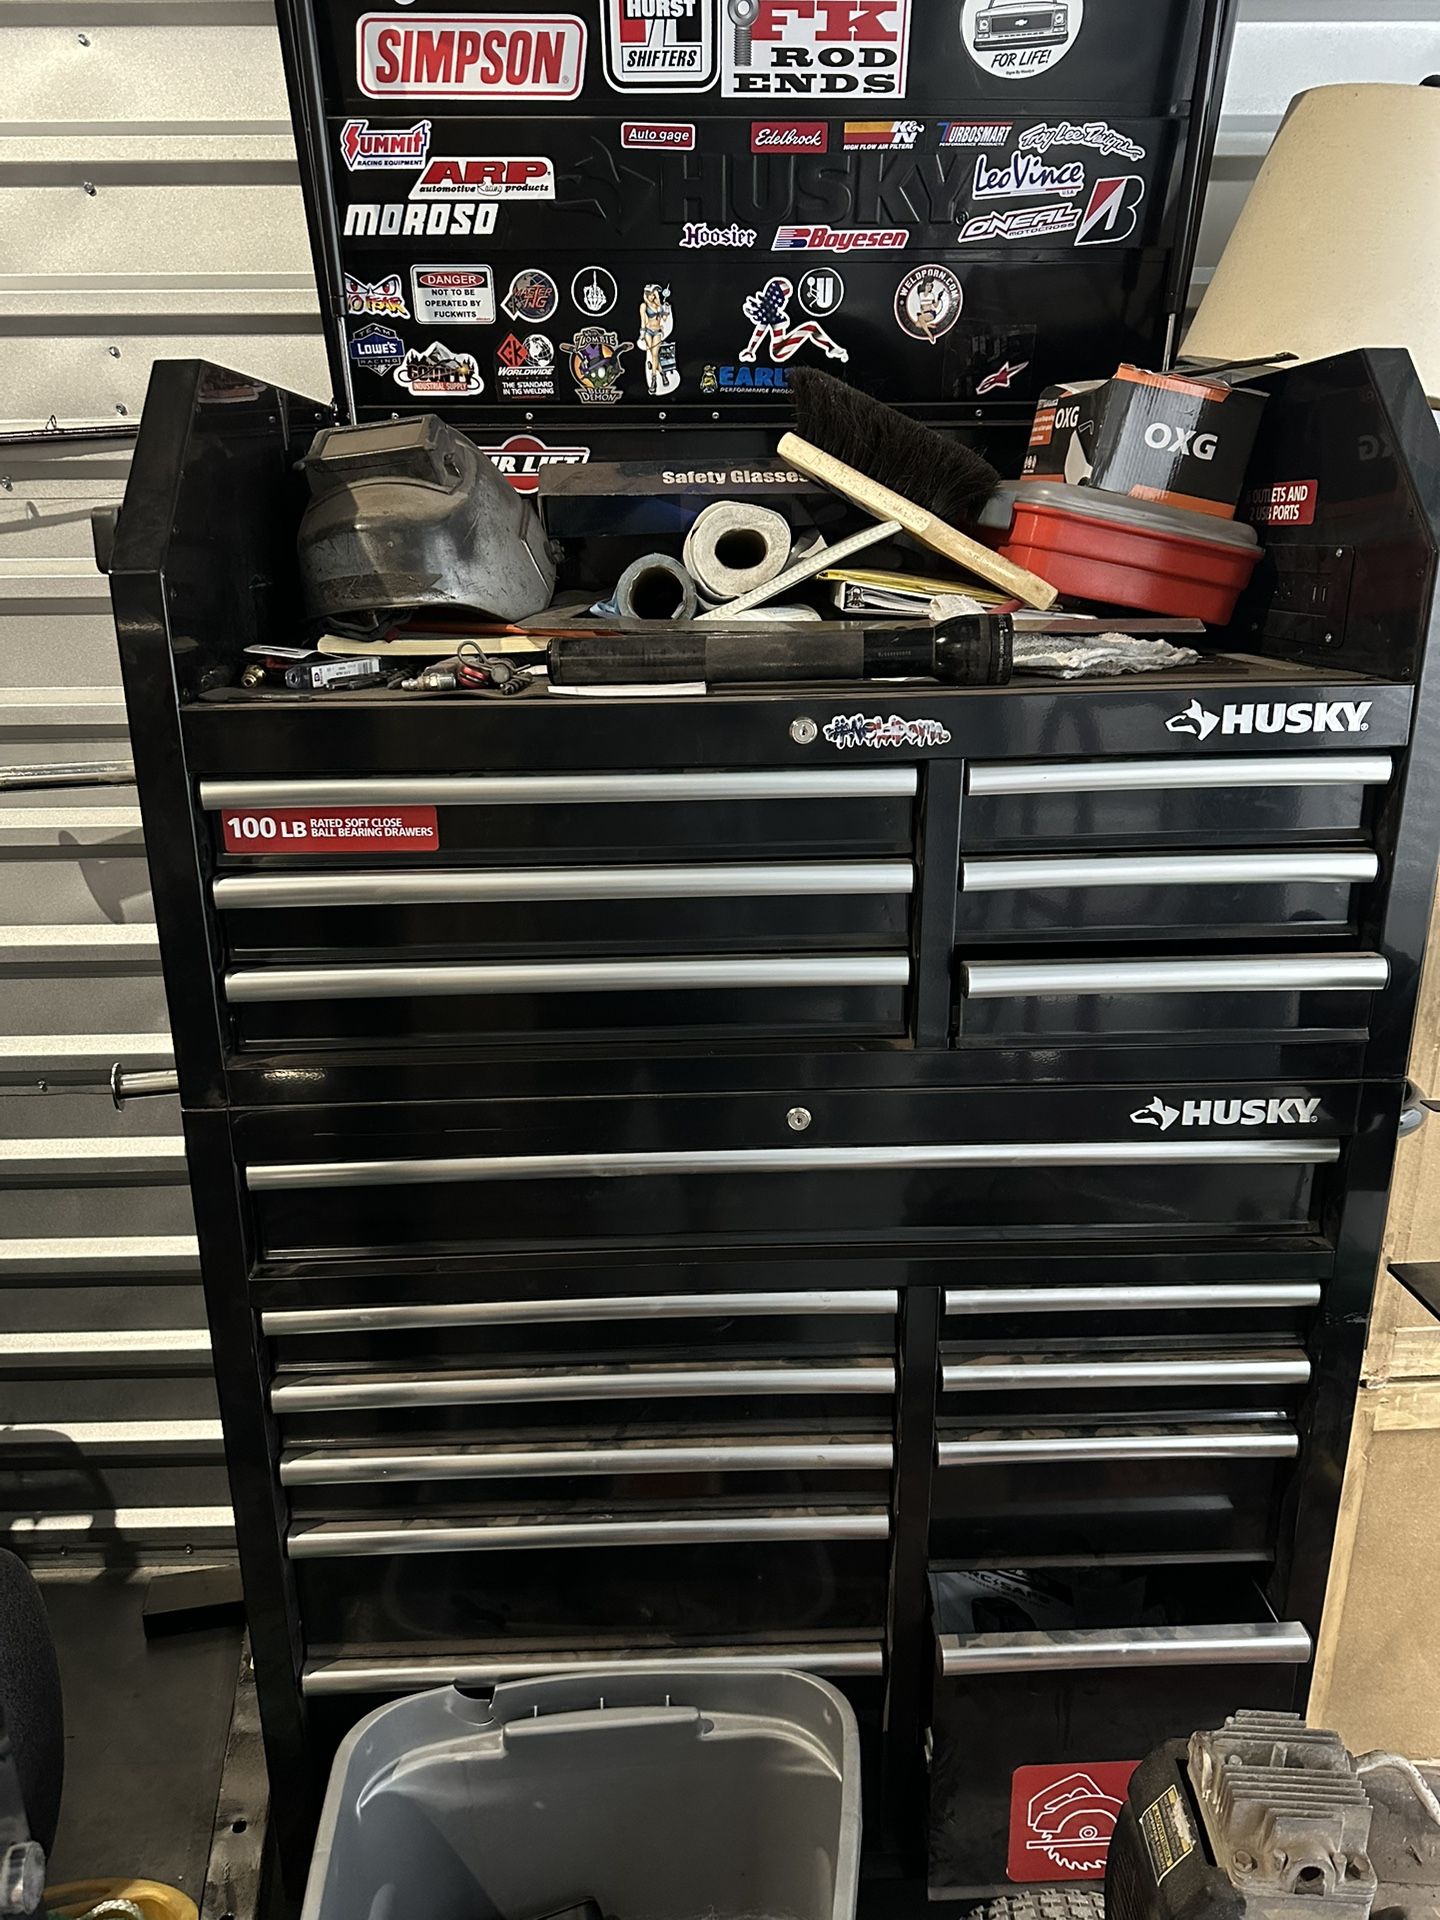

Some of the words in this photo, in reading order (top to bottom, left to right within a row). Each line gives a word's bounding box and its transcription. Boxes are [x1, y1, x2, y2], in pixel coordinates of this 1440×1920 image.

[627, 0, 696, 17] HURST
[751, 1, 897, 41] FK
[376, 28, 565, 85] SIMPSON
[627, 50, 697, 67] SHIFTERS
[771, 47, 897, 67] ROD
[991, 53, 1017, 68] FOR
[1019, 49, 1052, 66] LIFE!
[733, 73, 895, 93] ENDS
[629, 128, 656, 141] Auto
[659, 130, 689, 143] gage
[755, 129, 821, 145] Edelbrock
[937, 122, 1013, 142] TURBOSMART
[1022, 126, 1053, 149] Troy
[1056, 125, 1084, 141] Lee
[1085, 125, 1143, 154] Designs
[420, 161, 547, 184] ARP
[419, 185, 476, 193] automotive
[504, 183, 549, 192] products
[661, 154, 974, 225] HUSKY
[343, 204, 498, 235] MOROSO
[682, 225, 755, 246] Hoosier
[1009, 222, 1075, 236] MOTOCROSS
[808, 228, 906, 250] Boyesen
[427, 275, 477, 284] DANGER
[513, 285, 553, 297] MASTER
[348, 295, 364, 311] O
[360, 327, 390, 336] TEAM
[357, 341, 397, 355] LOWE'S
[498, 366, 554, 376] WORLDWIDE
[720, 366, 795, 387] EARL
[447, 382, 468, 390] SUPPLY
[582, 393, 617, 401] DEMON
[1055, 406, 1080, 429] OXG
[1144, 422, 1218, 461] OXG
[491, 456, 516, 472] IR
[662, 470, 726, 484] Safety
[1287, 485, 1308, 501] AND
[1272, 504, 1300, 520] PORTS
[1221, 701, 1373, 734] HUSKY
[227, 817, 277, 838] 100
[281, 821, 307, 837] LB
[310, 818, 343, 827] RATED
[345, 818, 370, 827] SOFT
[371, 818, 402, 827] CLOSE
[311, 828, 336, 837] BALL
[338, 828, 382, 837] BEARING
[384, 827, 433, 837] DRAWERS
[1182, 1098, 1321, 1125] HUSKY
